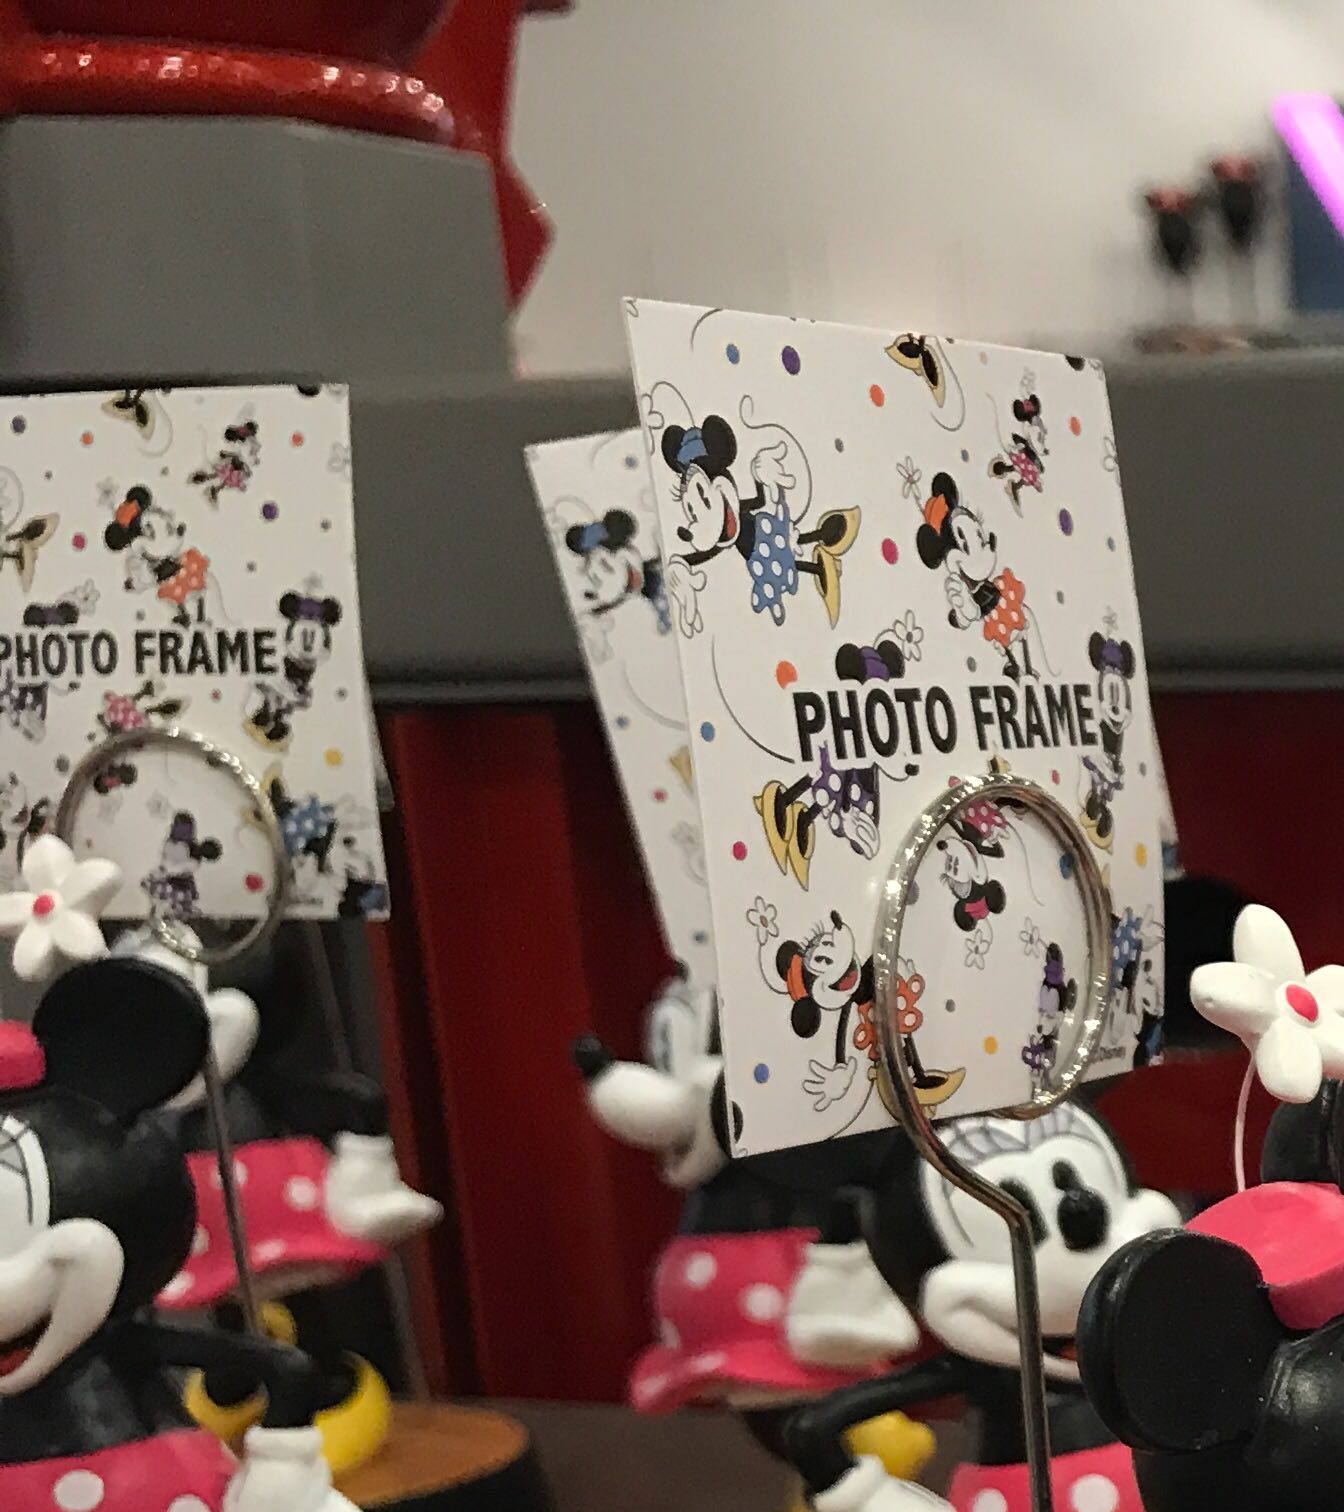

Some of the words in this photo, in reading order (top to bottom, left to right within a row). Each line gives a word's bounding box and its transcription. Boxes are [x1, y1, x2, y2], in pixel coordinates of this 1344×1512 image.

[134, 627, 279, 676] FRAME
[792, 685, 958, 762] PHOTO
[968, 683, 1099, 751] FRAME
